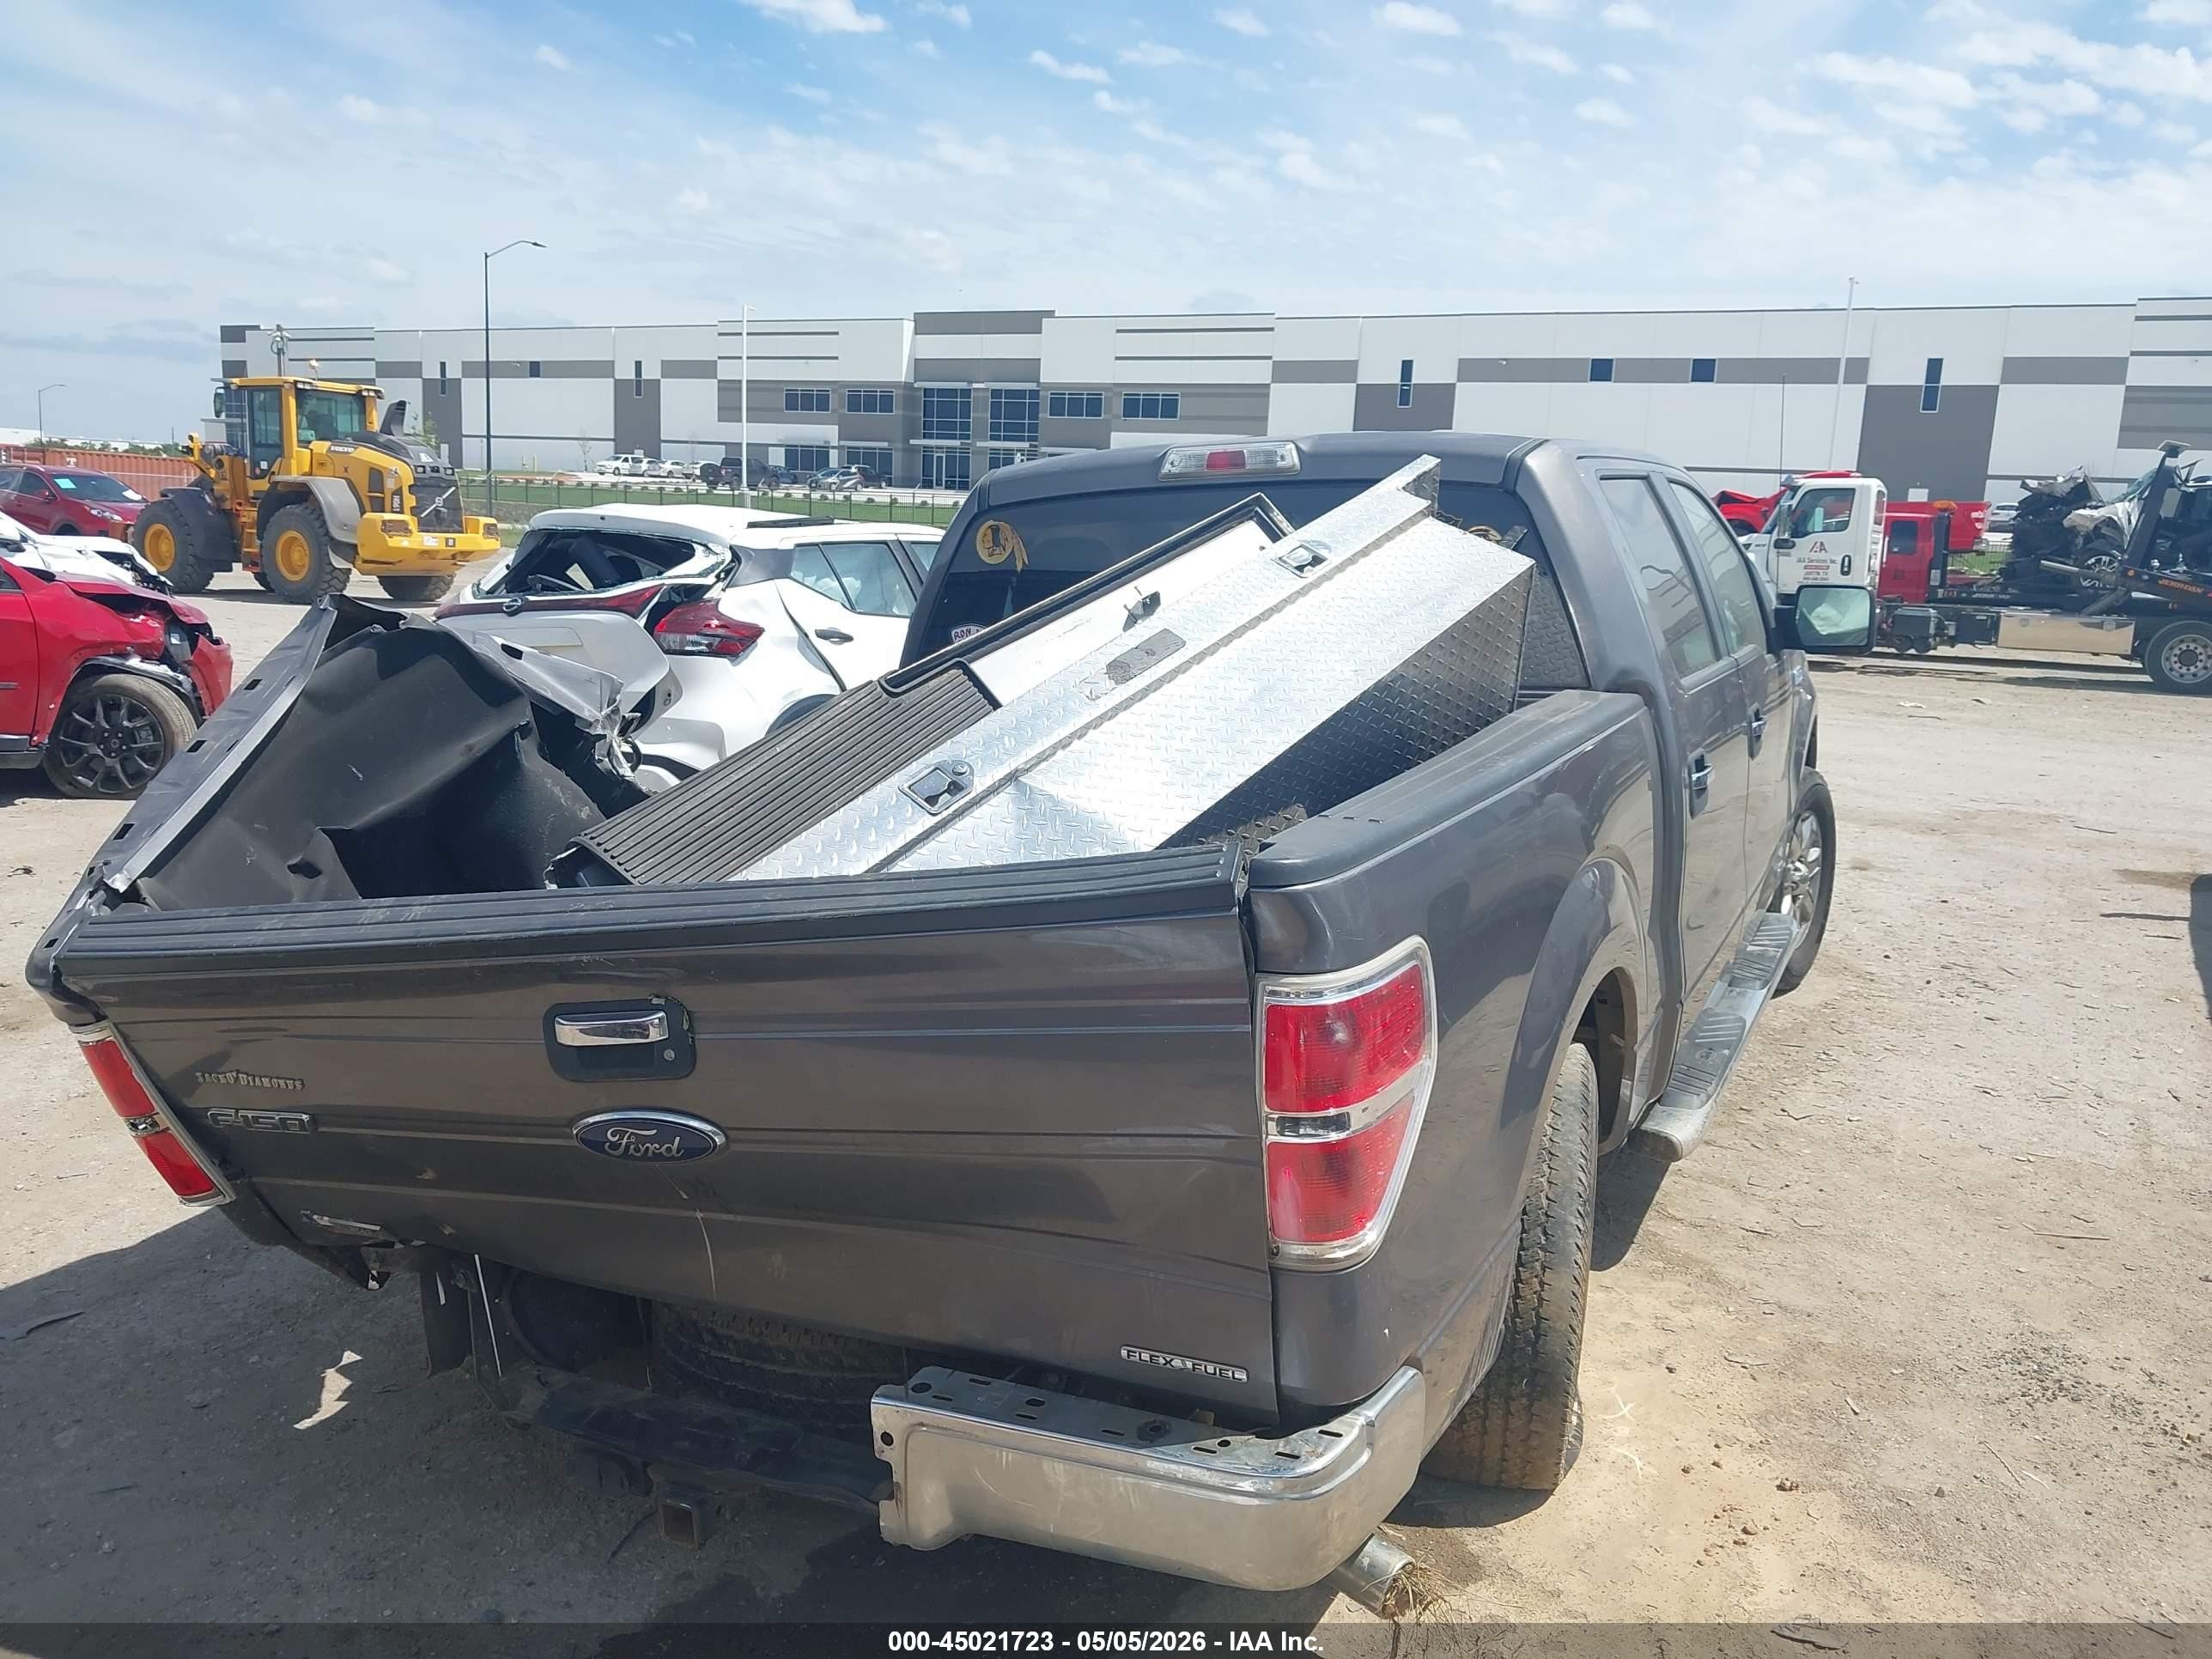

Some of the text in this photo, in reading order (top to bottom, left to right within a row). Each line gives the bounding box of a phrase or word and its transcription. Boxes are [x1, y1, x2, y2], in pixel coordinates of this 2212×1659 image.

[207, 1107, 312, 1134] F-150
[605, 1127, 684, 1158] Ford
[1126, 1349, 1243, 1382] FLEX FUEL
